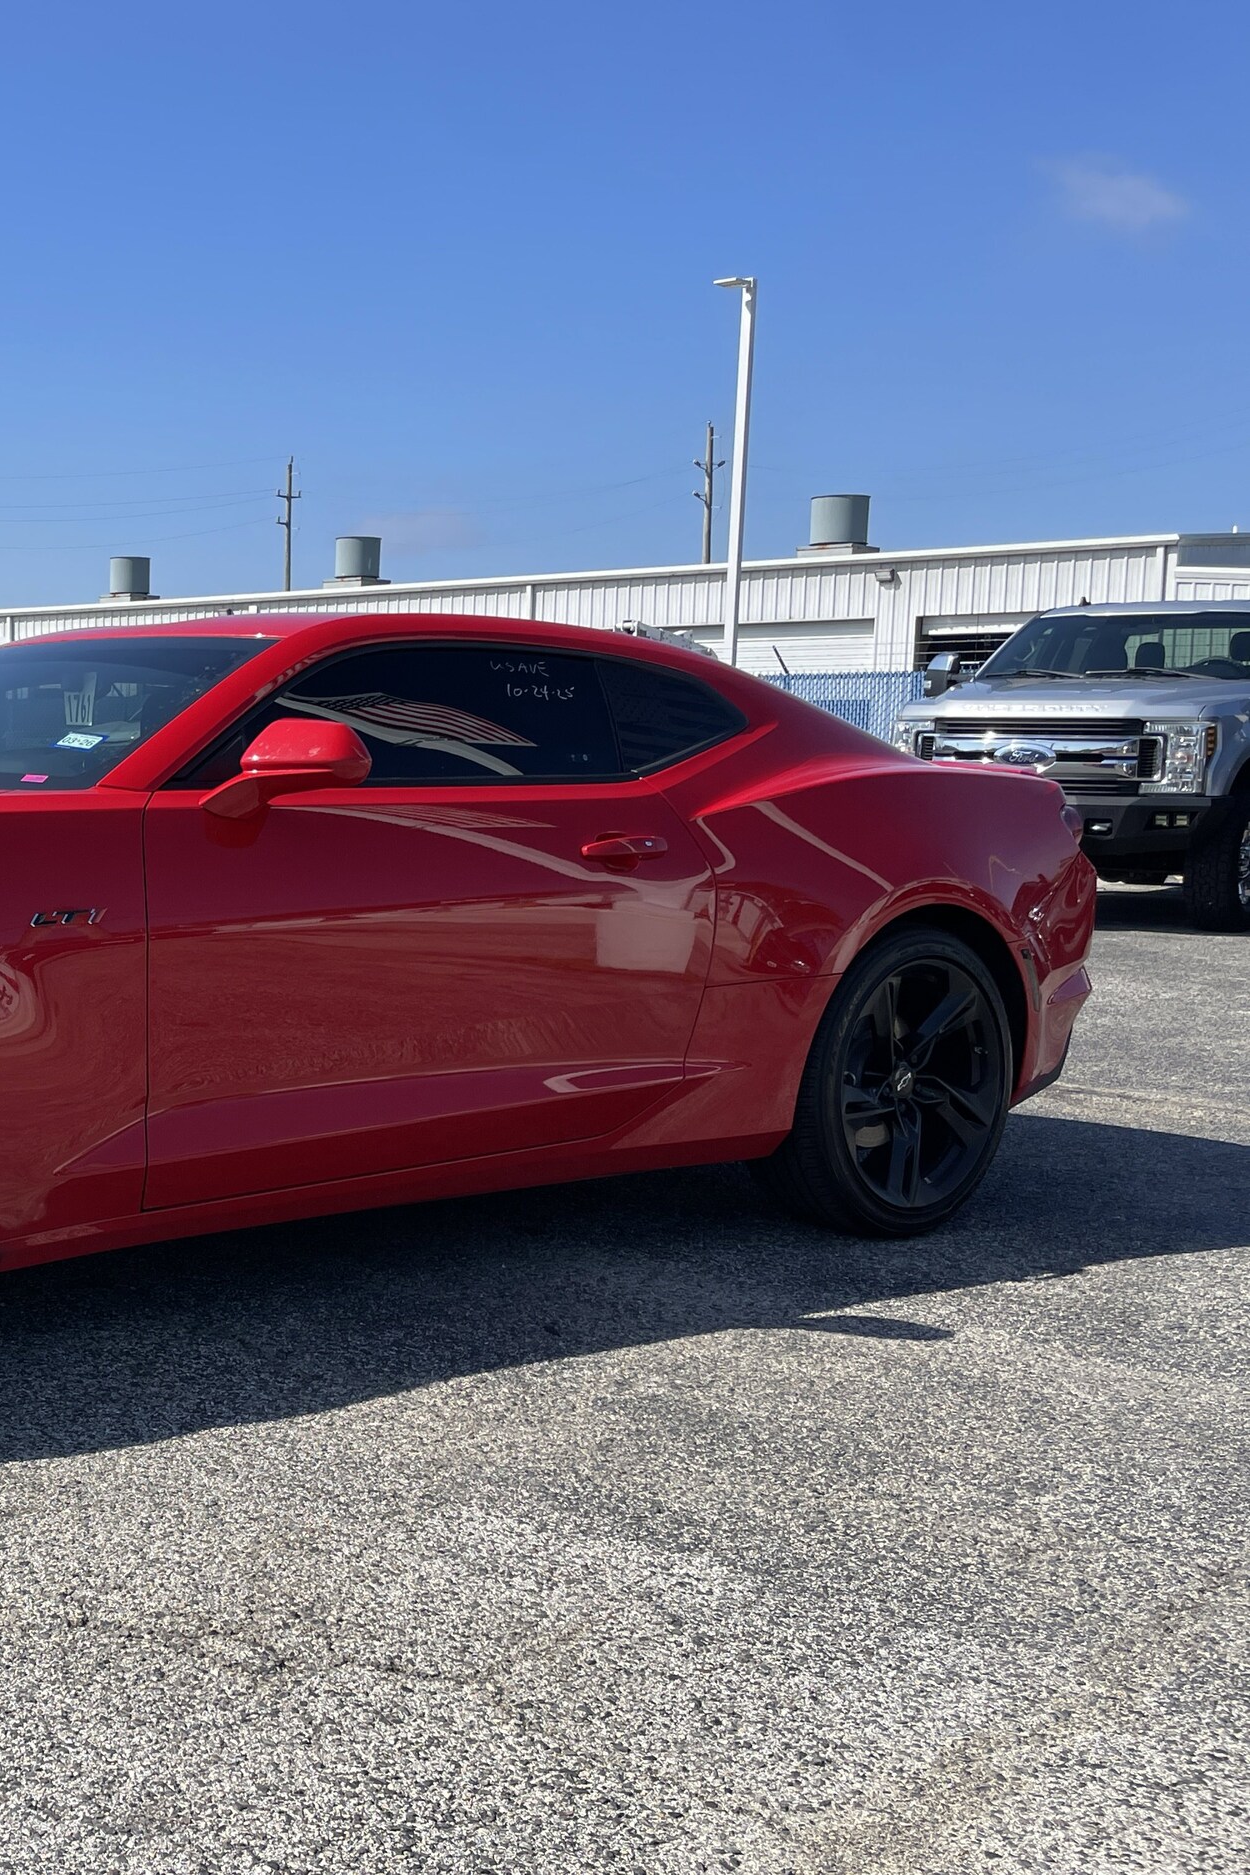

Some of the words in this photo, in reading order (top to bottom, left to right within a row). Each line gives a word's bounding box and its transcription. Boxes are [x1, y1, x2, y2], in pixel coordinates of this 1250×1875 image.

[67, 693, 91, 723] 1761
[1008, 749, 1039, 763] Ford
[30, 908, 108, 928] LT1
